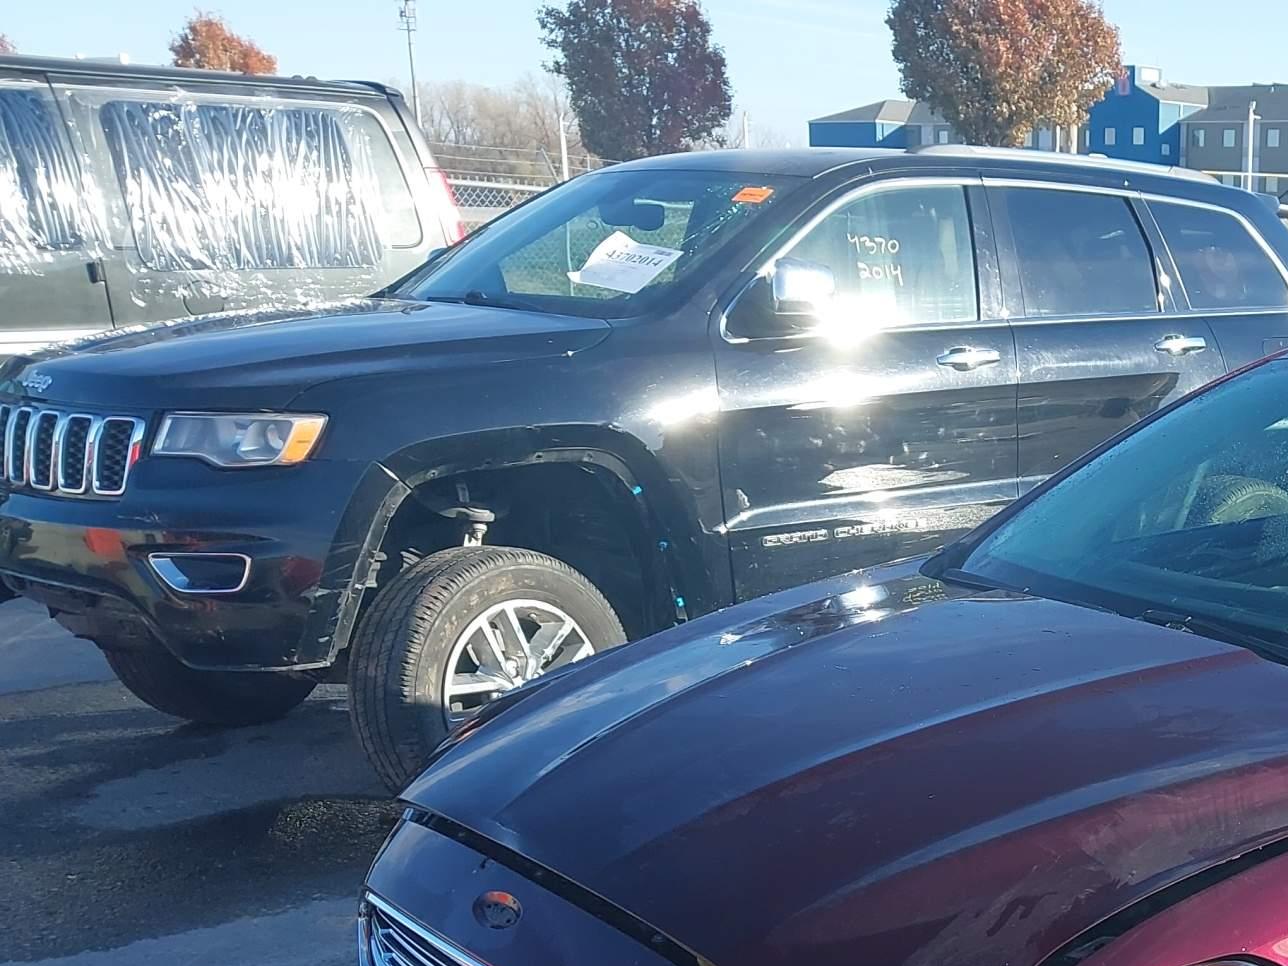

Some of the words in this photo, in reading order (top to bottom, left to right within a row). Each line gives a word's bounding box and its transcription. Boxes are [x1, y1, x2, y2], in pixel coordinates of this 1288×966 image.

[846, 233, 900, 255] 4370
[605, 250, 664, 268] 43702014
[857, 261, 904, 287] 2014
